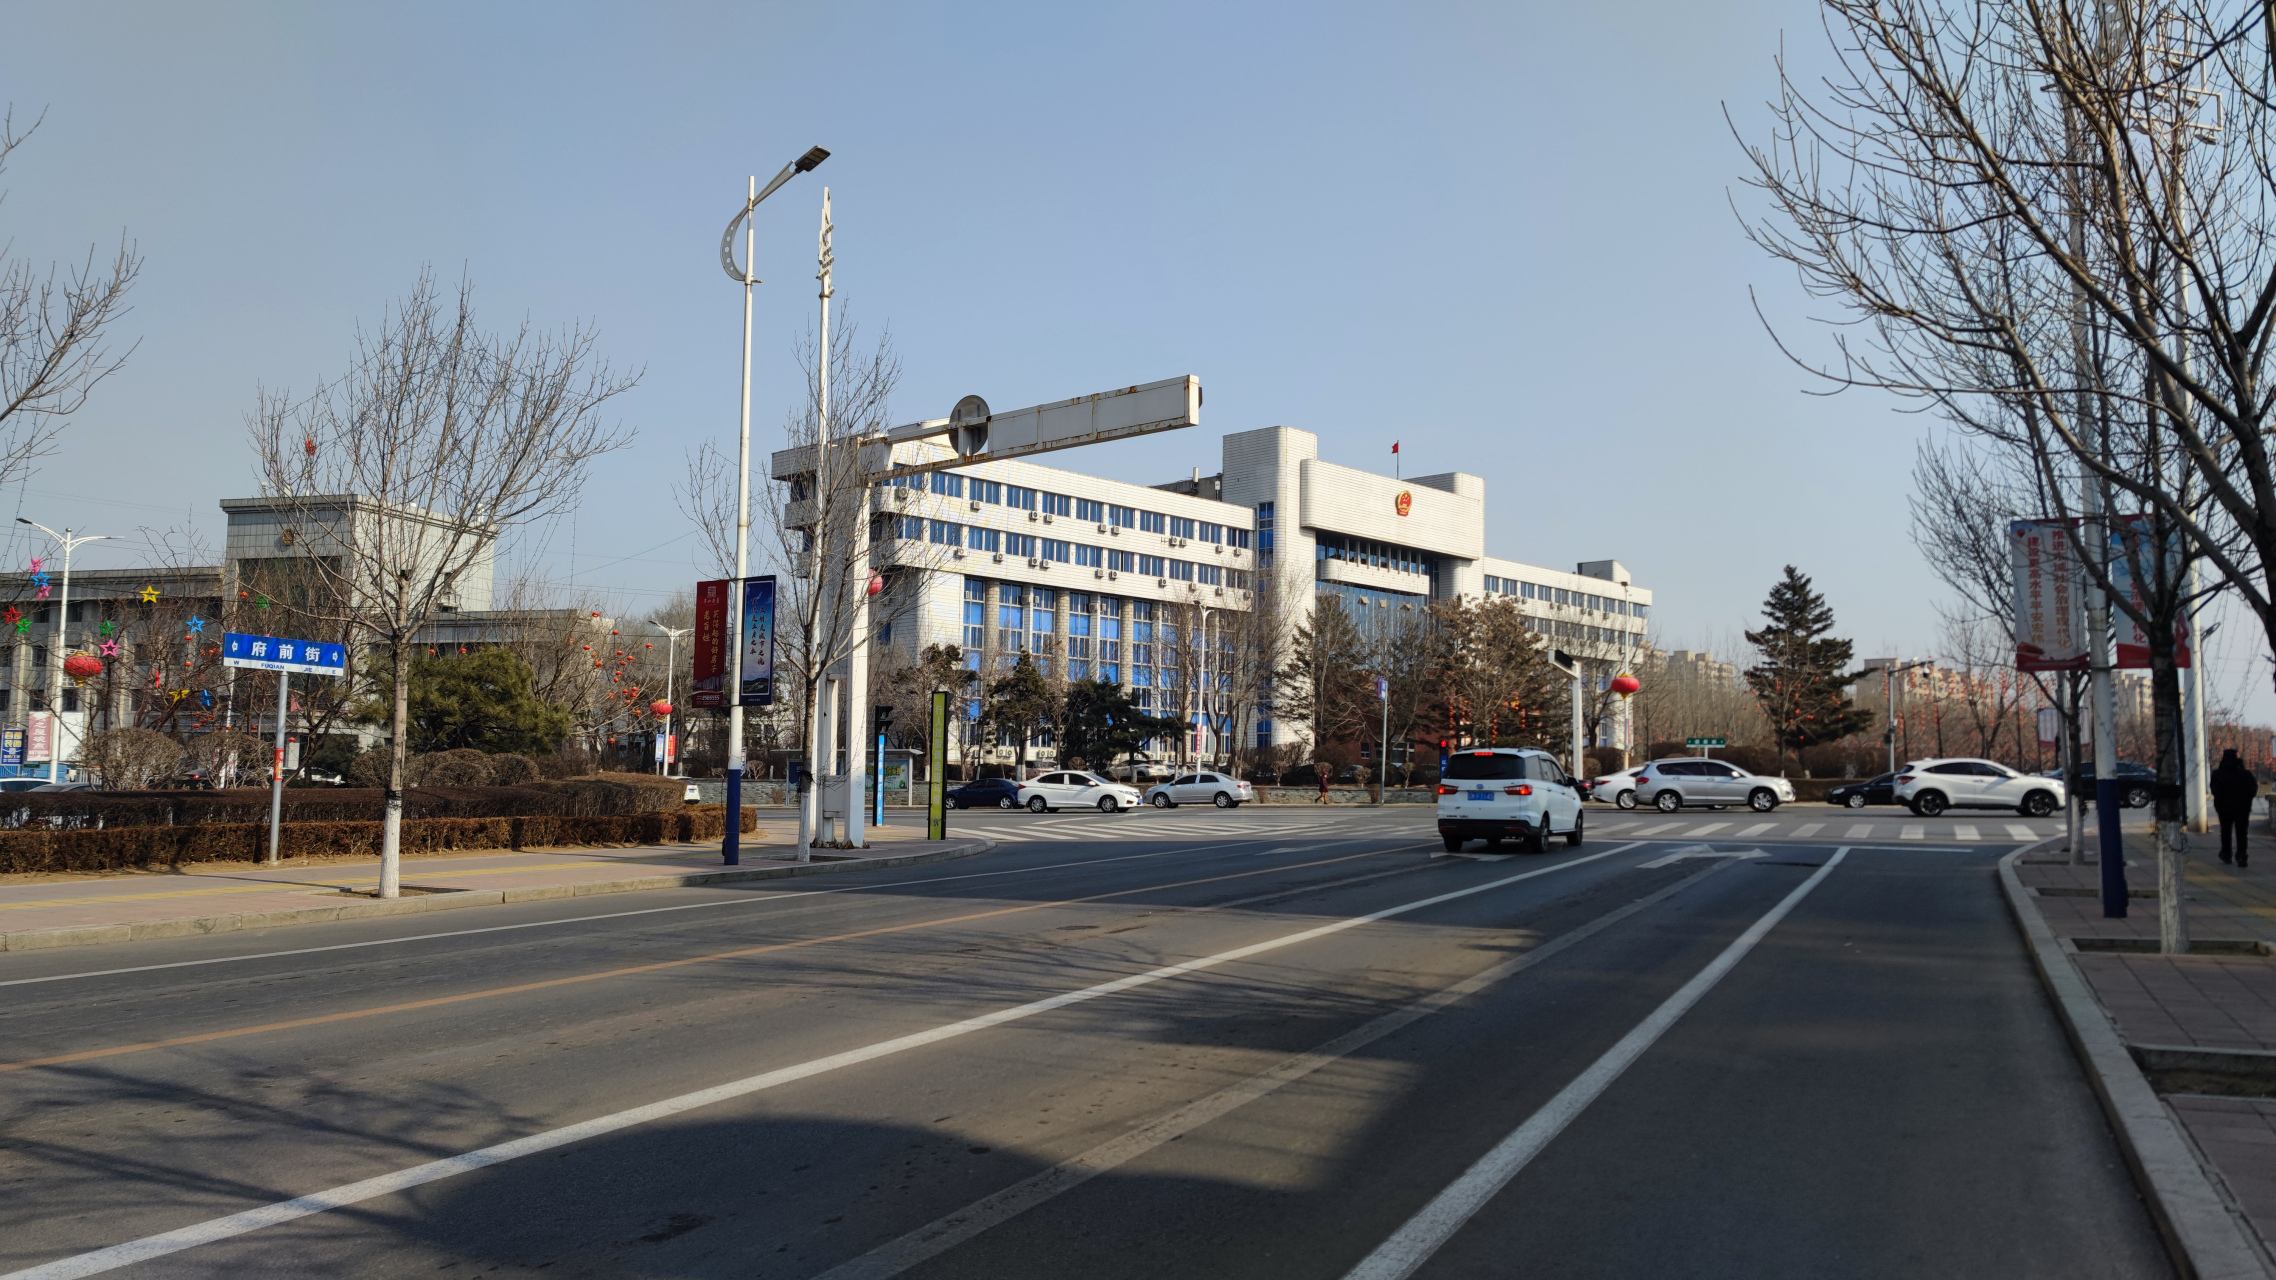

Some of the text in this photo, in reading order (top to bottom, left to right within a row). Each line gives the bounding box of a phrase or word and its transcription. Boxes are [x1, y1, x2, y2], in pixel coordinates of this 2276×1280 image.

[702, 610, 710, 642] 老百姓
[251, 641, 320, 663] 府前街
[710, 609, 719, 673] 买得起的好房子
[260, 662, 285, 670] FUQIAN
